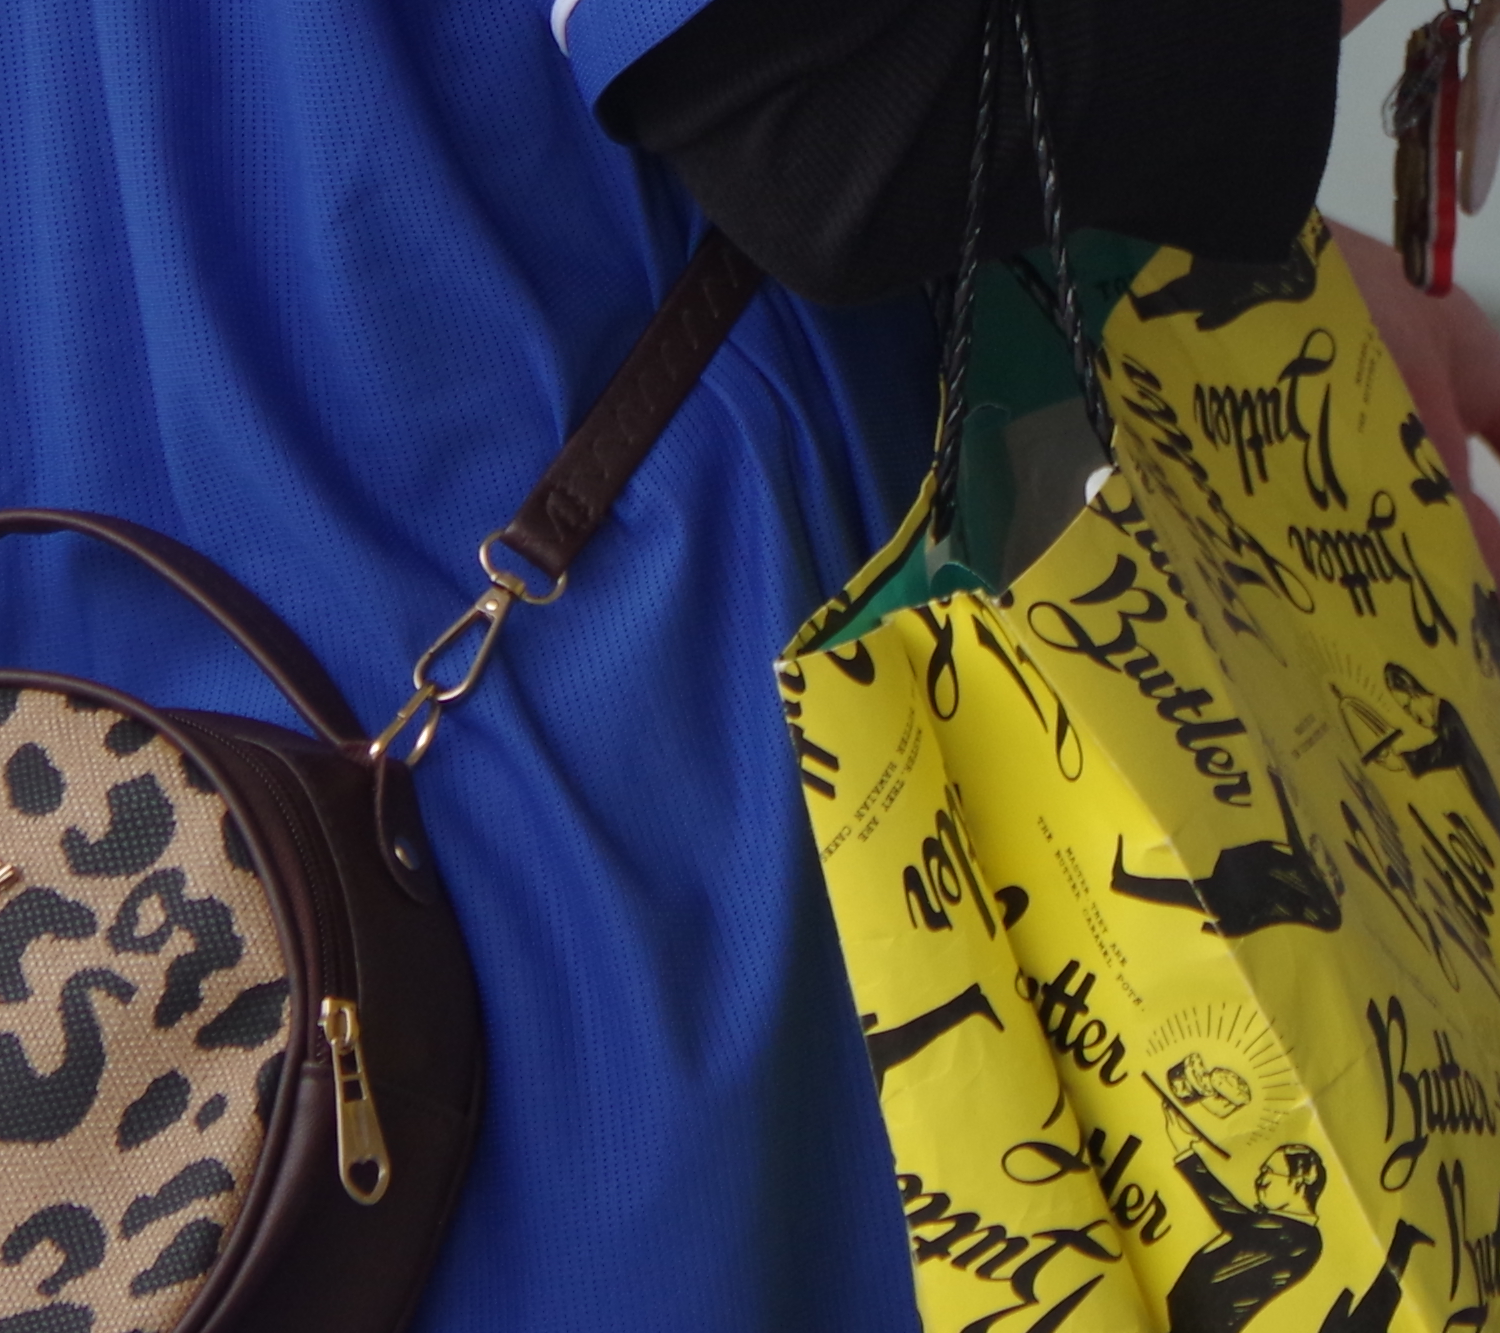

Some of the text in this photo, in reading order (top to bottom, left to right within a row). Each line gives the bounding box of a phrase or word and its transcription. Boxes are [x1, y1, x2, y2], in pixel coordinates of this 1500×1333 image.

[1195, 328, 1347, 510] Butler
[1289, 491, 1458, 647] Butter
[1027, 553, 1253, 808] Butler
[903, 783, 997, 940] ler
[1366, 995, 1496, 1193] Butter
